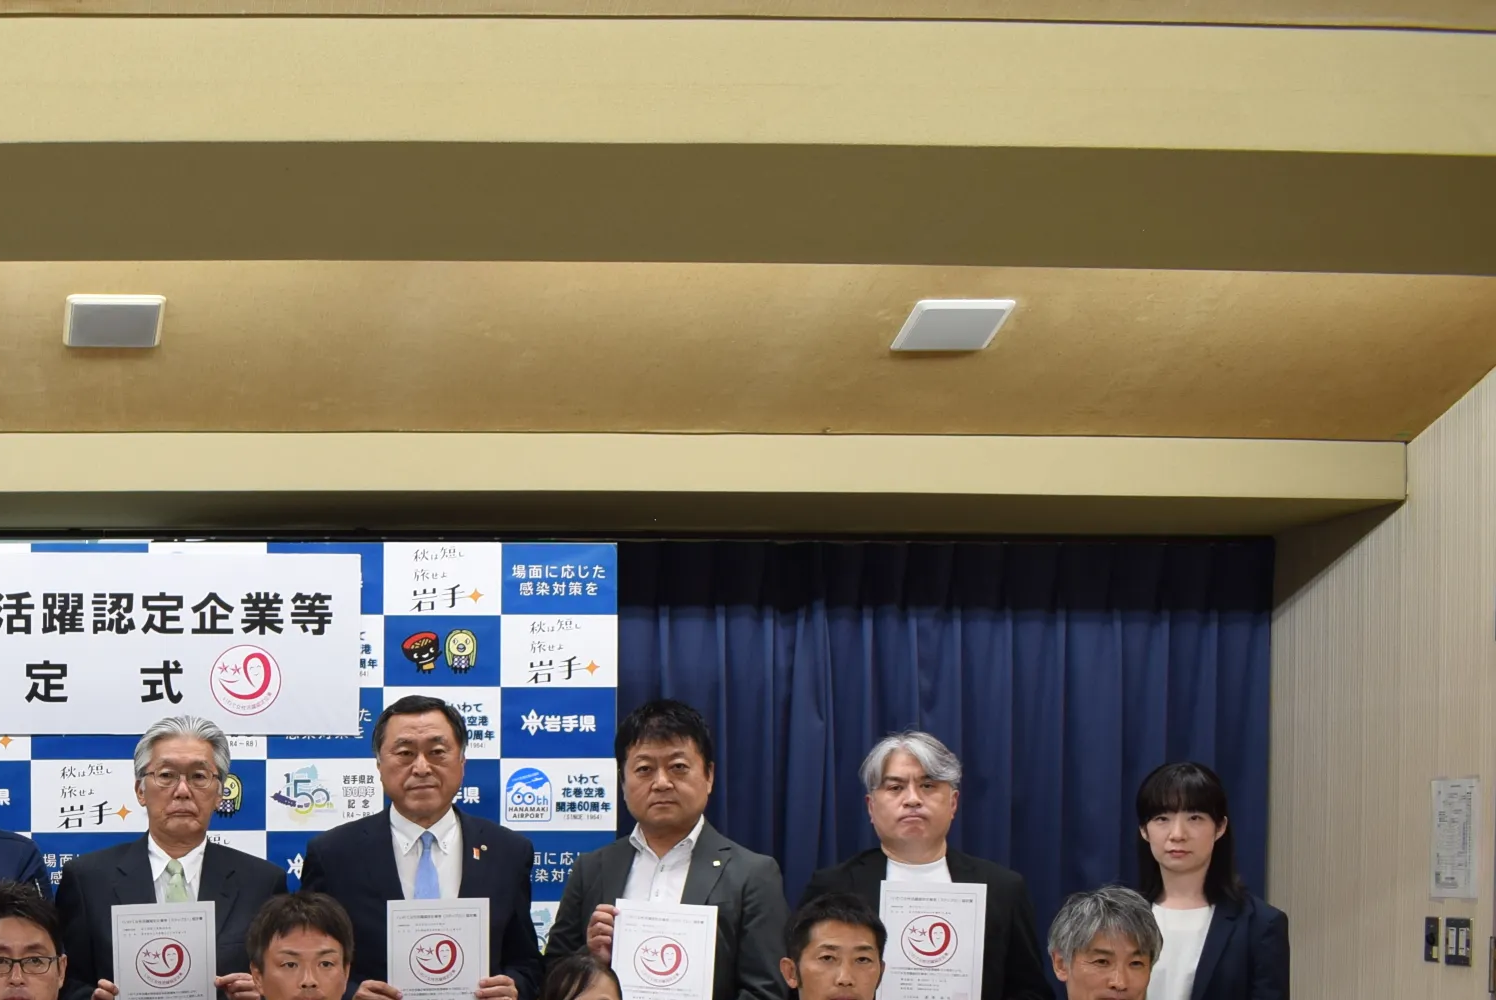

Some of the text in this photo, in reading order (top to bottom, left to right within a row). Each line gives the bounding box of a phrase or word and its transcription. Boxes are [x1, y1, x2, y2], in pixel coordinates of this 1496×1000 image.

[412, 546, 464, 562] 秋は短し
[413, 569, 448, 581] 旅せよ
[511, 564, 606, 579] 場面に応じた
[519, 582, 598, 596] 感染対策を
[409, 584, 466, 612] 岩手
[529, 618, 581, 634] 秋は短し
[529, 641, 564, 654] 旅せよ
[526, 656, 584, 684] 岩手
[466, 716, 488, 726] 空港
[544, 715, 596, 732] 岩手県
[60, 763, 112, 779] 秋は短し
[342, 775, 374, 784] 岩手県政
[567, 774, 600, 784] いわて
[60, 786, 95, 799] 旅せよ
[342, 786, 375, 798] 150周年
[562, 788, 605, 798] 花巻空港
[556, 801, 611, 812] 開港60周年
[57, 800, 113, 829] 岩手
